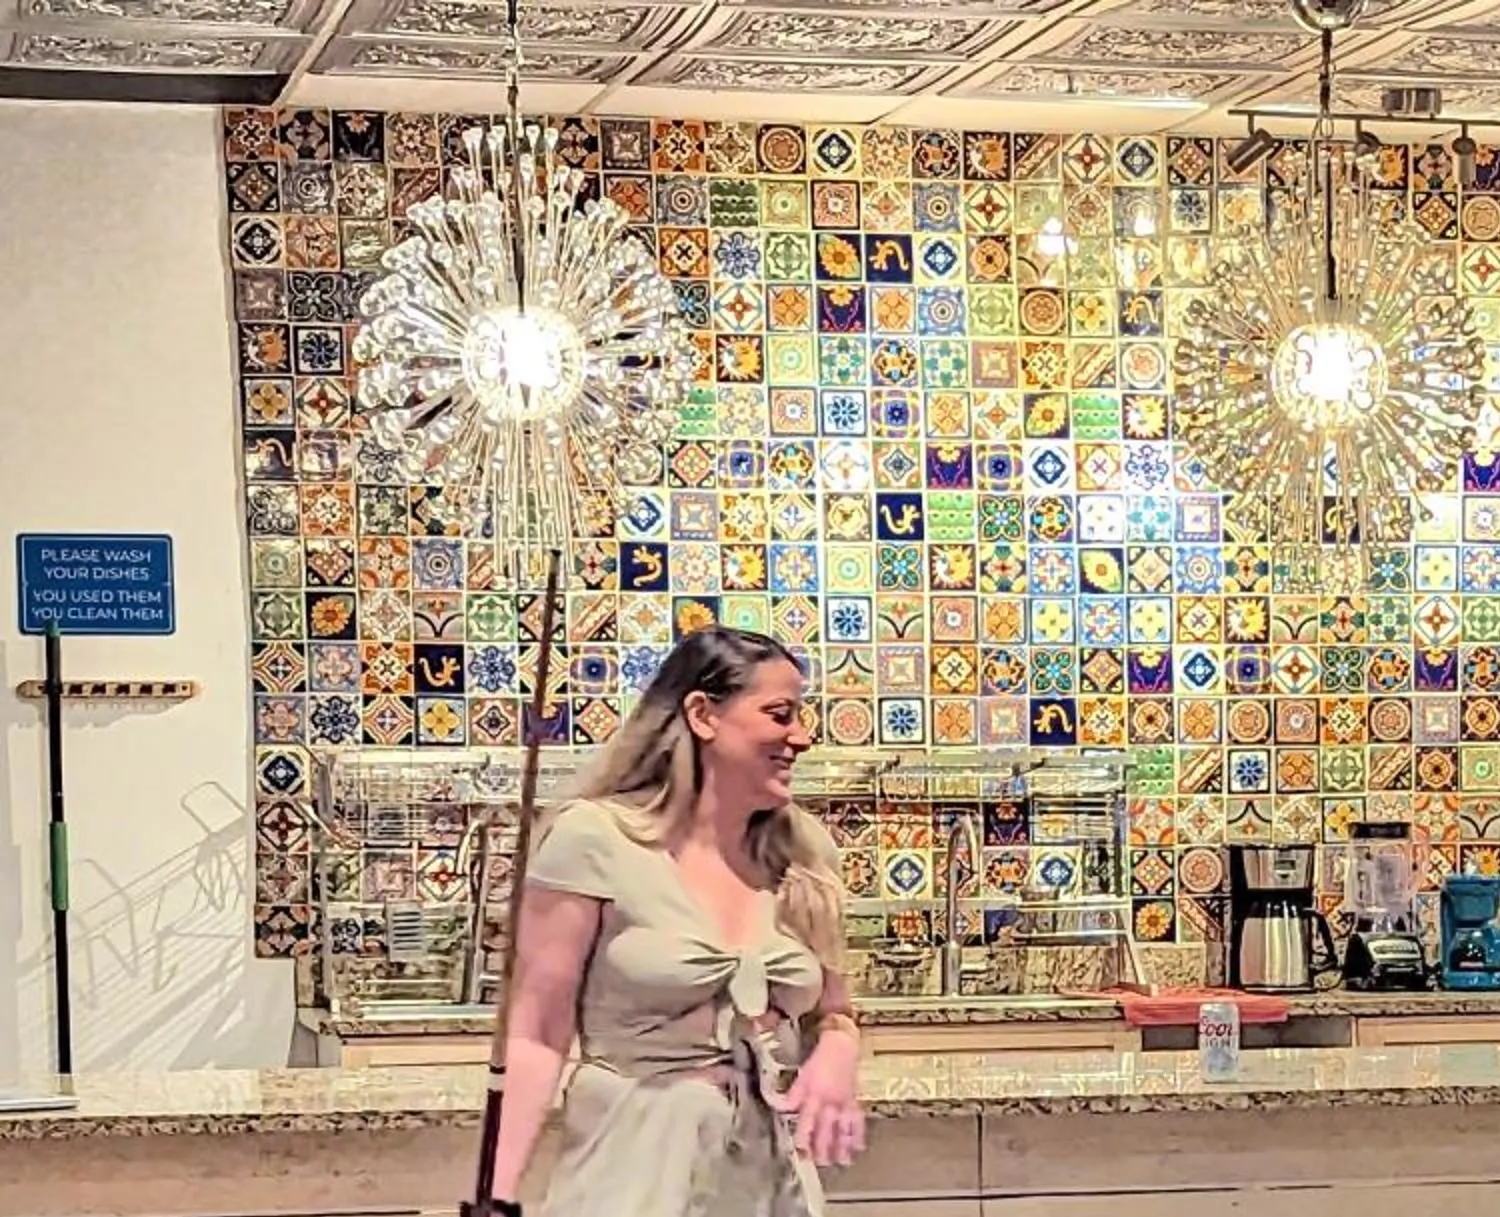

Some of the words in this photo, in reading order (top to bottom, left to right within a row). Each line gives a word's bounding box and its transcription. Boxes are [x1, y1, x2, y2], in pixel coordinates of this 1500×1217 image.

[41, 549, 100, 563] PLEASE
[104, 550, 151, 563] WASH
[44, 567, 89, 579] YOUR
[93, 568, 149, 581] DISHES
[33, 590, 66, 602] YOU
[71, 590, 114, 603] USED
[117, 590, 161, 603] THEM
[32, 607, 63, 619] YOU
[67, 607, 117, 620] CLEAN
[122, 608, 163, 620] THEM
